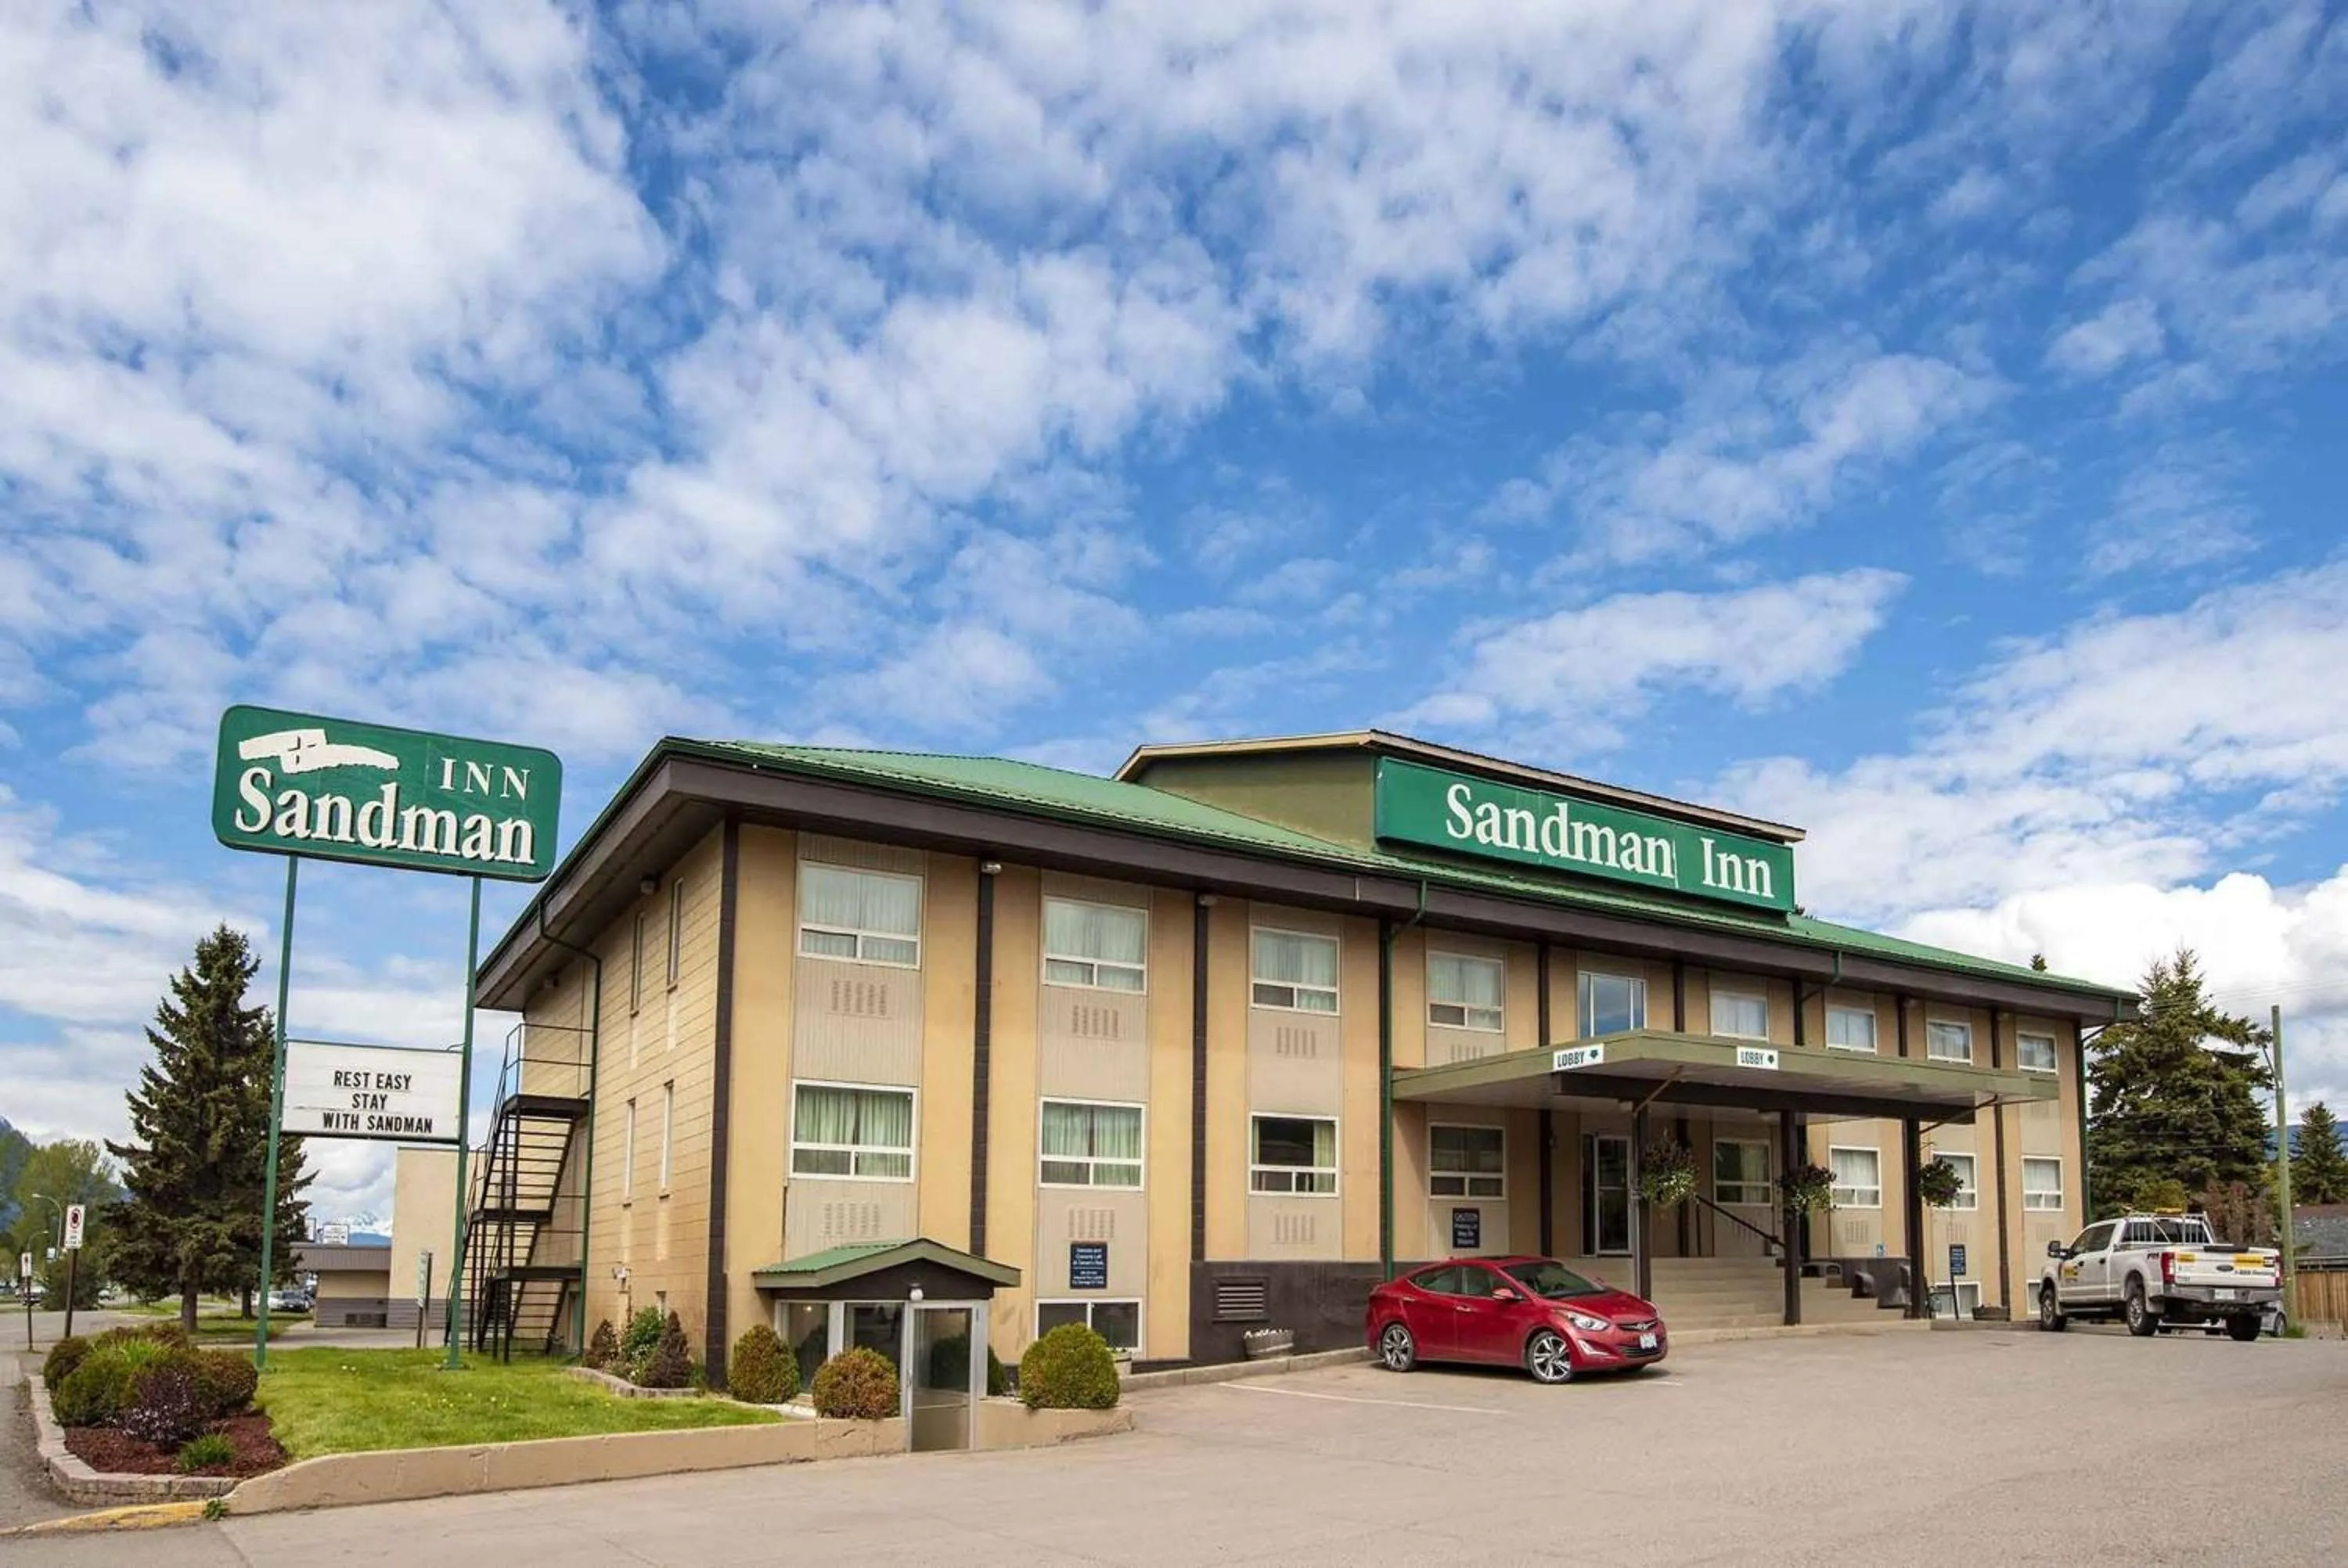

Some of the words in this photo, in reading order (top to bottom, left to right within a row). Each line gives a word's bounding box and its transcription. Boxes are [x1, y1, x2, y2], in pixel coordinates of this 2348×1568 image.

[439, 757, 531, 801] INN
[236, 767, 535, 865] Sandman
[1445, 782, 1676, 879] Sandman
[1700, 836, 1775, 899] Inn
[1557, 1051, 1585, 1068] LOBBY
[1740, 1051, 1765, 1065] LOBBY
[333, 1070, 371, 1088] REST
[376, 1073, 412, 1090] EASY
[351, 1093, 388, 1110] STAY
[322, 1112, 359, 1131] WITH
[367, 1115, 433, 1134] SANDMAN
